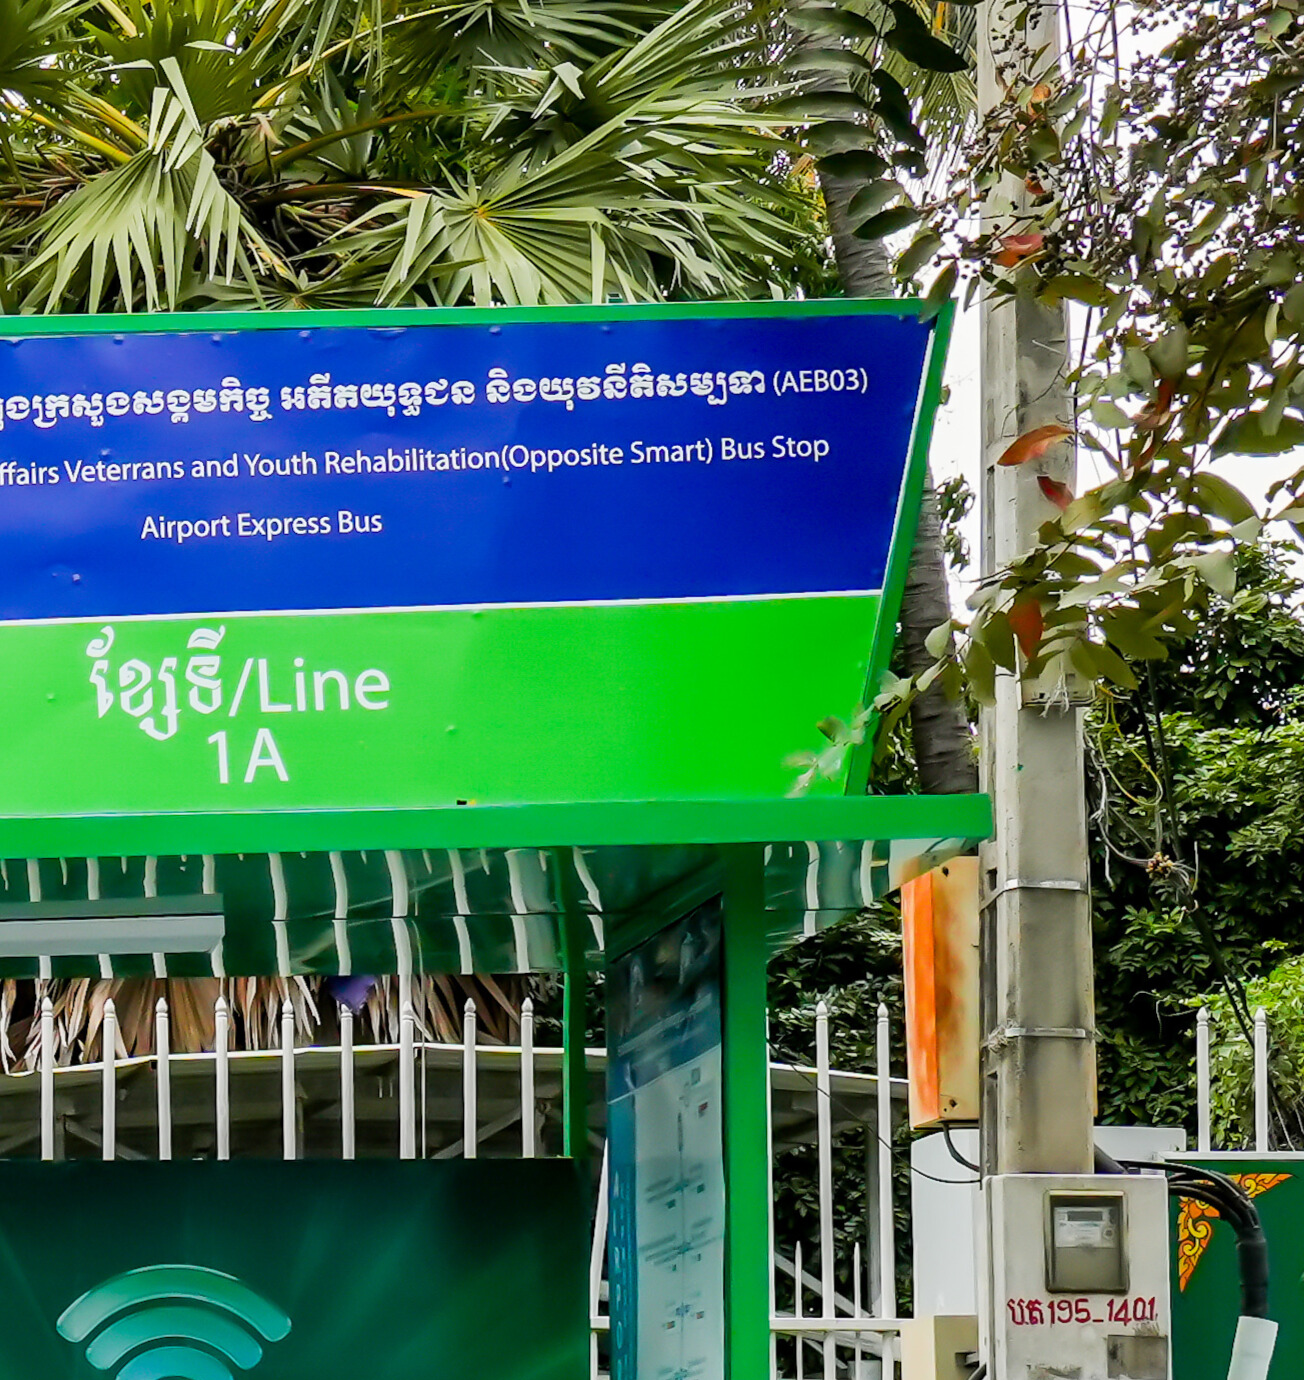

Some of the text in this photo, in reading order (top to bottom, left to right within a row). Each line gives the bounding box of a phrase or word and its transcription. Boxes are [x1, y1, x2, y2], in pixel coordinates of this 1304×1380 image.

[773, 368, 868, 396] (AEB03)
[64, 457, 185, 484] Veterrans
[191, 453, 239, 479] and
[244, 450, 318, 477] Youth
[325, 444, 624, 474] Rehabilitation(Opposite
[630, 438, 713, 465] Smart)
[721, 437, 765, 460] Bus
[772, 435, 829, 462] Stop
[140, 510, 383, 543] Airport Express Bus
[207, 727, 289, 785] 1A
